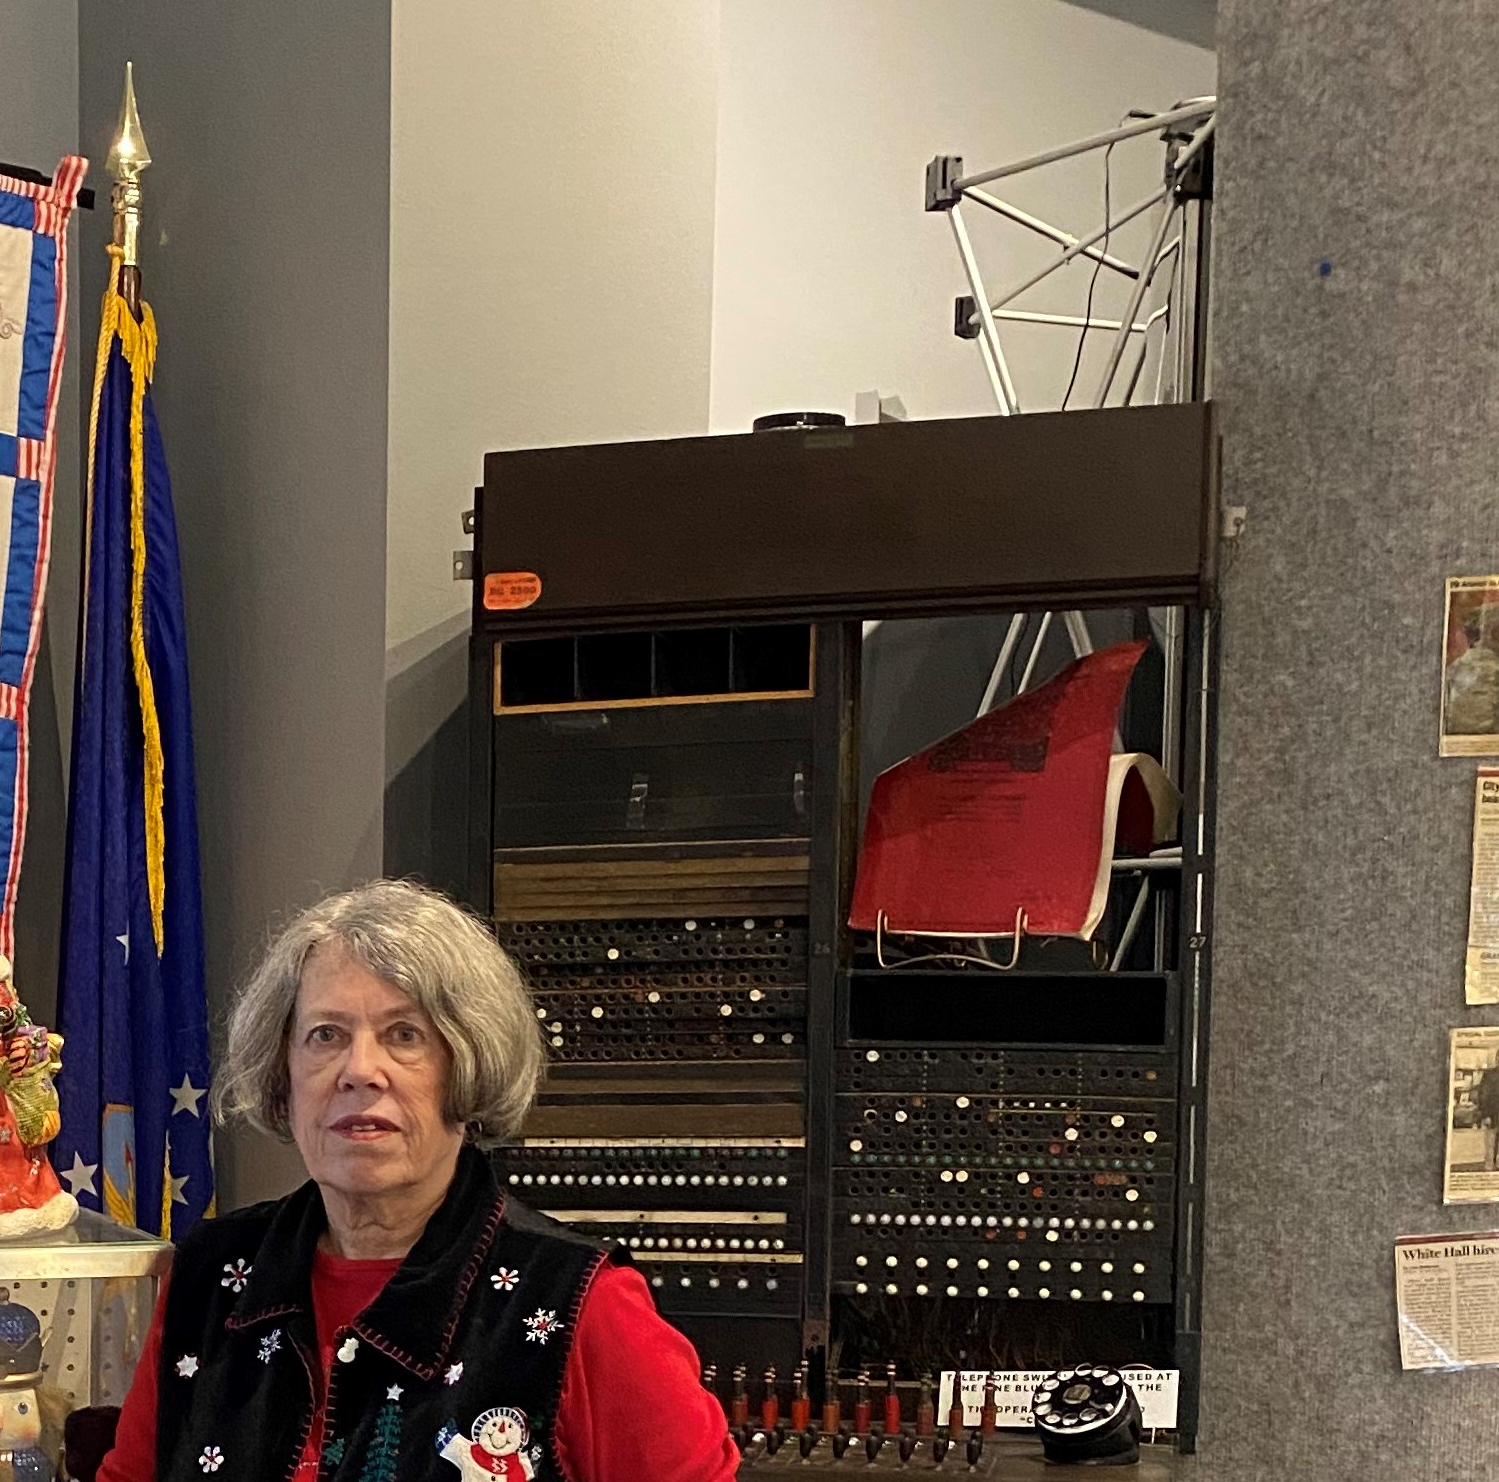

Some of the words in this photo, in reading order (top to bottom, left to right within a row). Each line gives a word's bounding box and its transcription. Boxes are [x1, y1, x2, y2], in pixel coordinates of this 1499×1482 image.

[1189, 936, 1207, 949] 27
[1402, 1248, 1442, 1261] White
[1444, 1244, 1470, 1257] Hall
[1156, 1372, 1172, 1381] AT
[1138, 1383, 1162, 1392] THE
